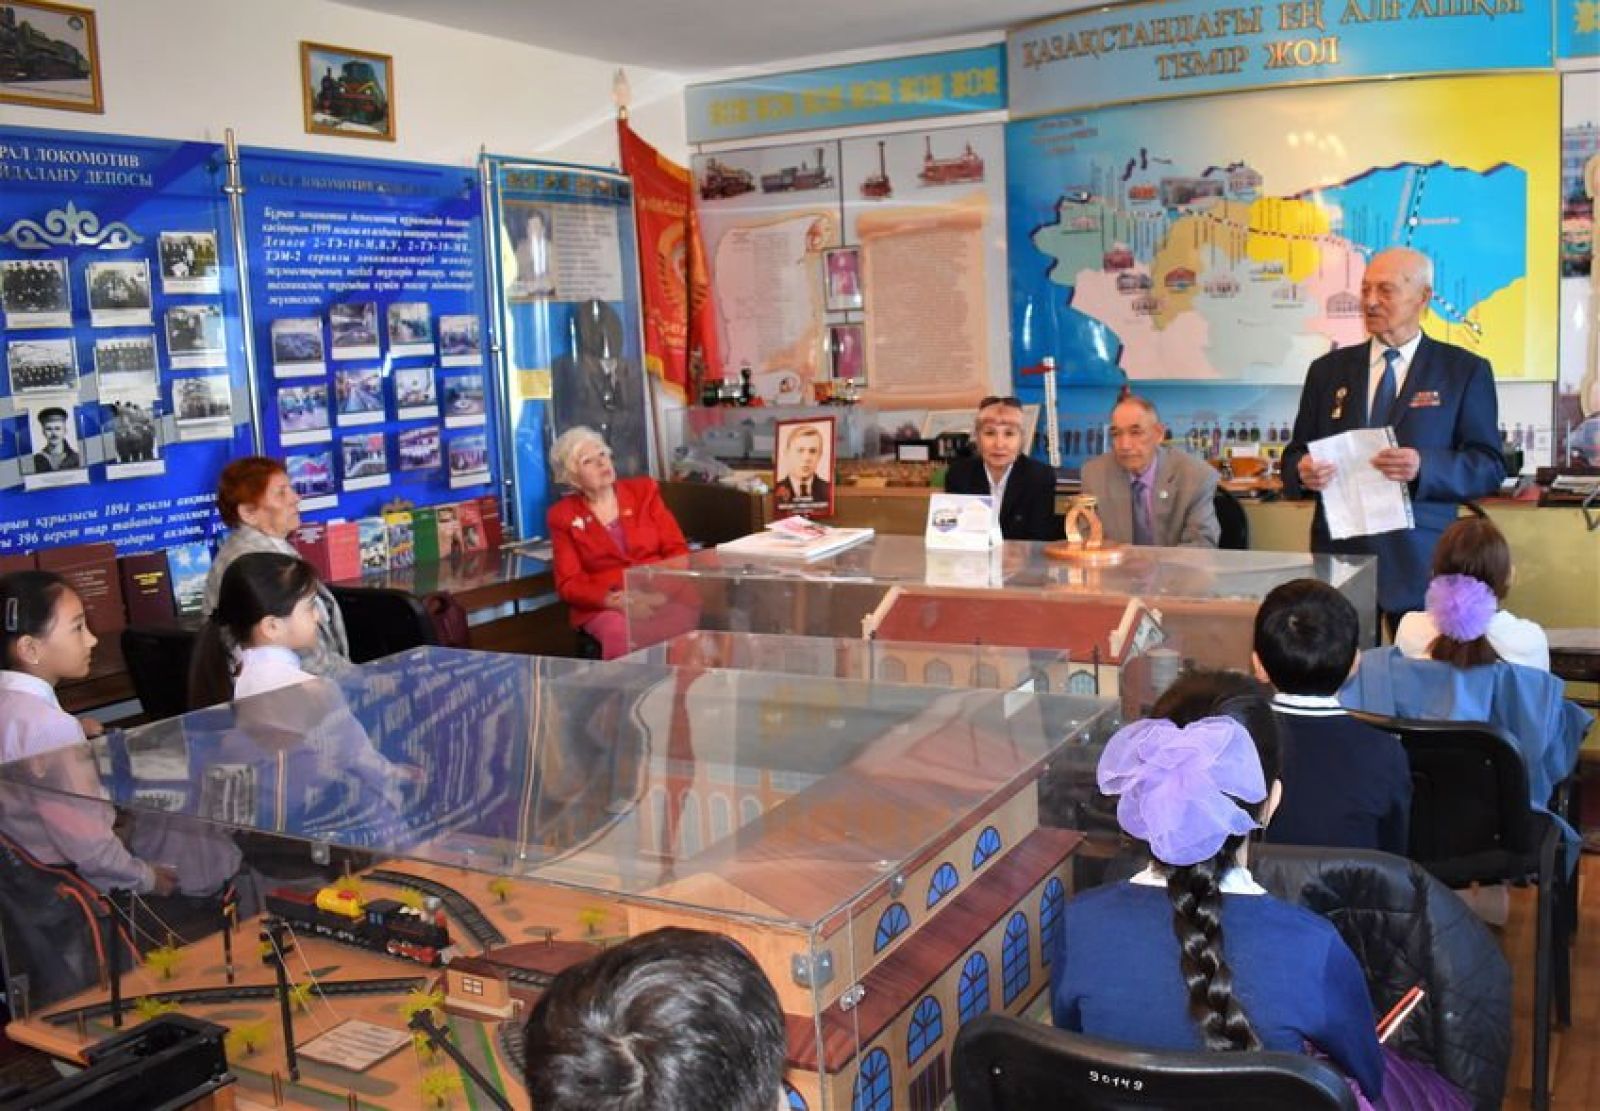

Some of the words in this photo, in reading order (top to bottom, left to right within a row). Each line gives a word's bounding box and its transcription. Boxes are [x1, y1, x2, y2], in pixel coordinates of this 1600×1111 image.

[1022, 7, 1263, 70] ҚАЗАҚСТАНДАҒЫ
[1155, 46, 1249, 80] ТЕМІР
[1264, 36, 1340, 70] ЖОЛ
[34, 148, 139, 167] ЛОКОМОТИВ
[84, 170, 152, 187] ДЕПОСЫ
